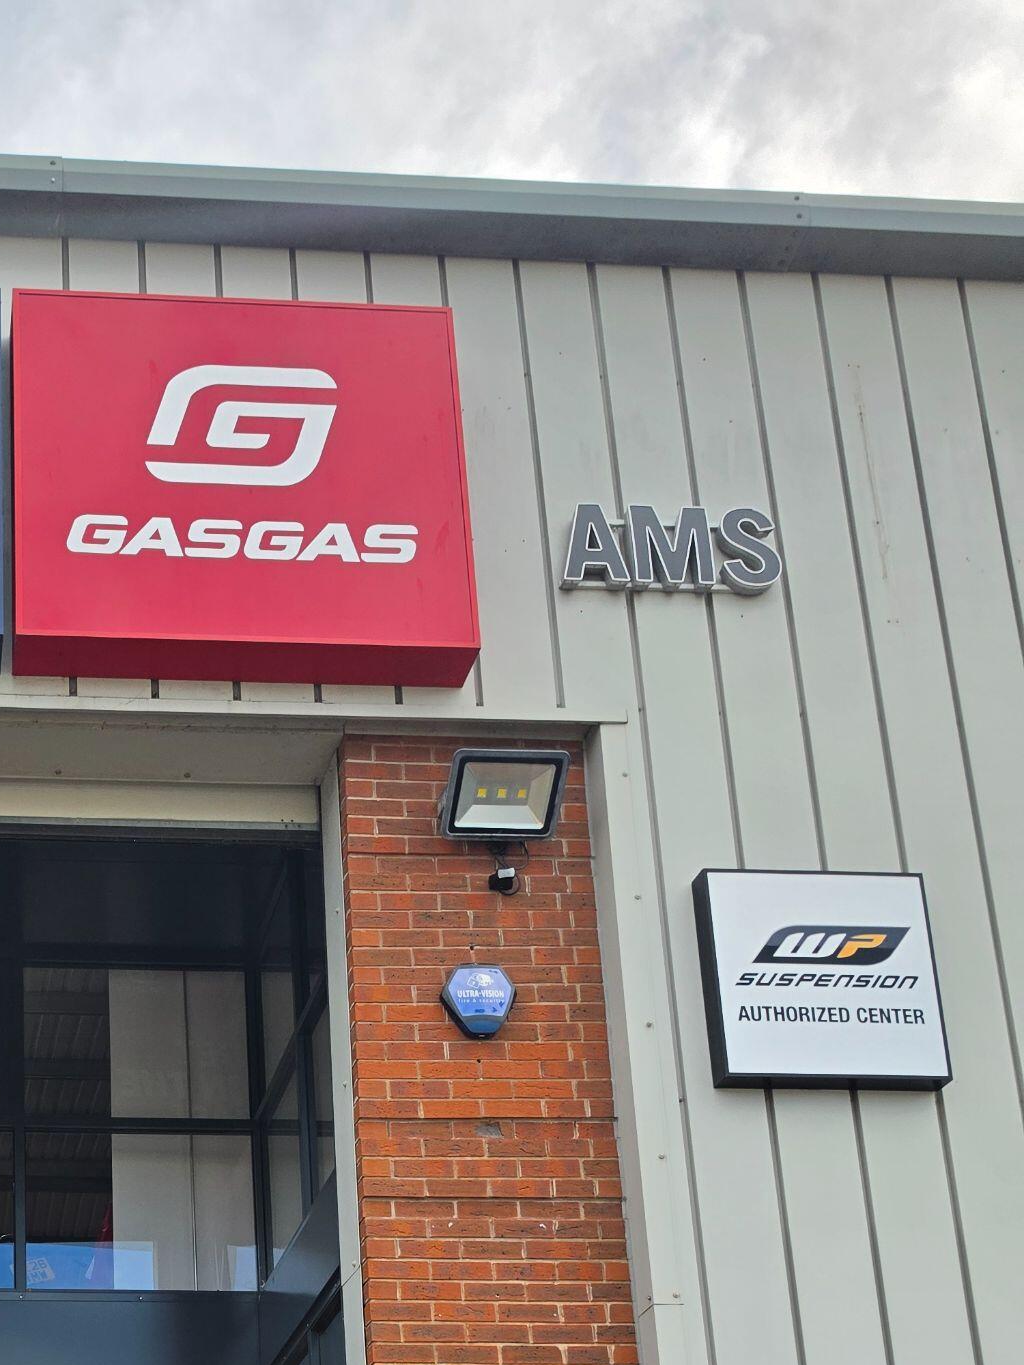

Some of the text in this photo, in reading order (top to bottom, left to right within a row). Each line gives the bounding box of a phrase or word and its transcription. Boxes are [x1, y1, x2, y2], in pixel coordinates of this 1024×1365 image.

[66, 513, 419, 564] GASGAS
[561, 502, 782, 594] AMS
[773, 932, 888, 959] WP
[735, 972, 919, 989] SUSPENSION
[457, 990, 505, 999] ULTRA-VISION
[738, 1005, 926, 1025] AUTHORIZED CENTER
